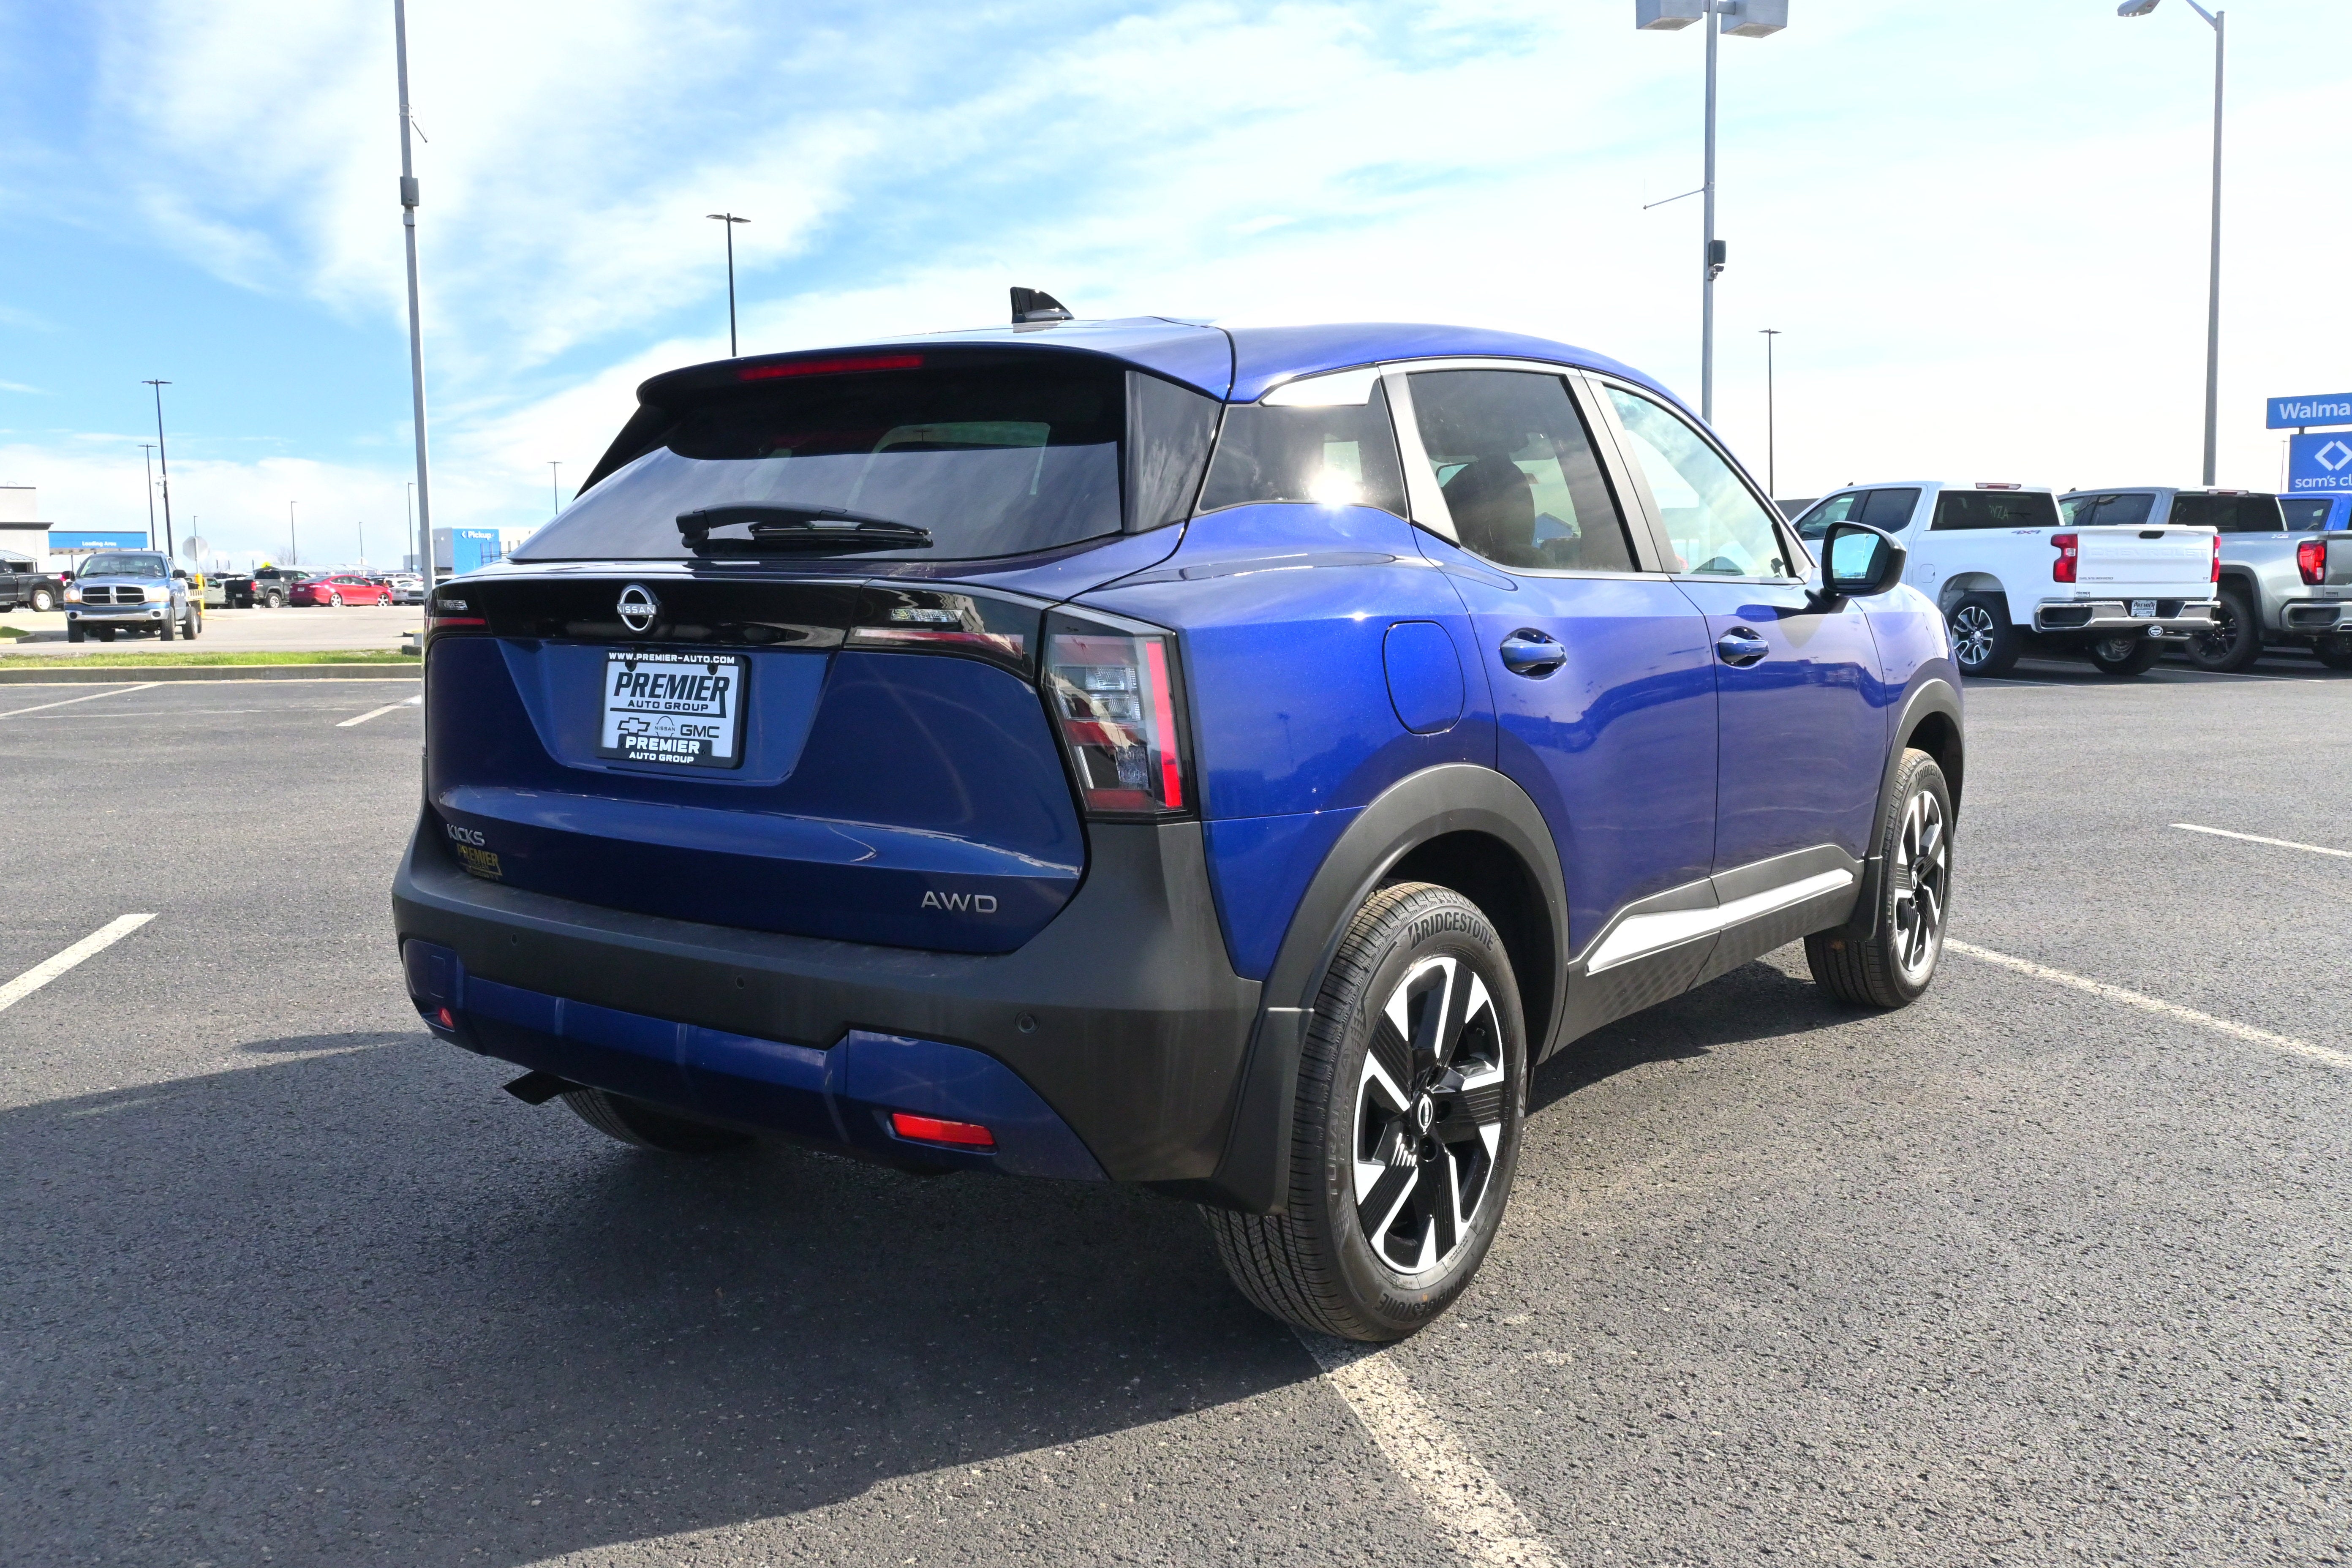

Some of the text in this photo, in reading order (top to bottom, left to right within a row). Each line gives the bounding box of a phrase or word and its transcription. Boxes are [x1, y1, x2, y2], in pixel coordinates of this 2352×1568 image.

[2279, 401, 2352, 419] Walma
[2295, 474, 2352, 488] sam's cl
[468, 531, 491, 540] Pickup
[2091, 549, 2207, 558] CHEVROLET
[617, 606, 655, 614] NISSAN
[609, 652, 735, 664] WWW.PREMIER-AUTO.COM
[613, 672, 730, 706] PREMIER
[627, 700, 709, 712] AUTO GROUP
[680, 724, 720, 738] GMC
[625, 736, 700, 754] PREMIER
[629, 751, 694, 763] AUTO GROUP
[447, 824, 485, 847] KICKS
[457, 843, 499, 866] PREMIER
[921, 891, 997, 913] AWD
[1407, 911, 1494, 951] BRIDGESTONE
